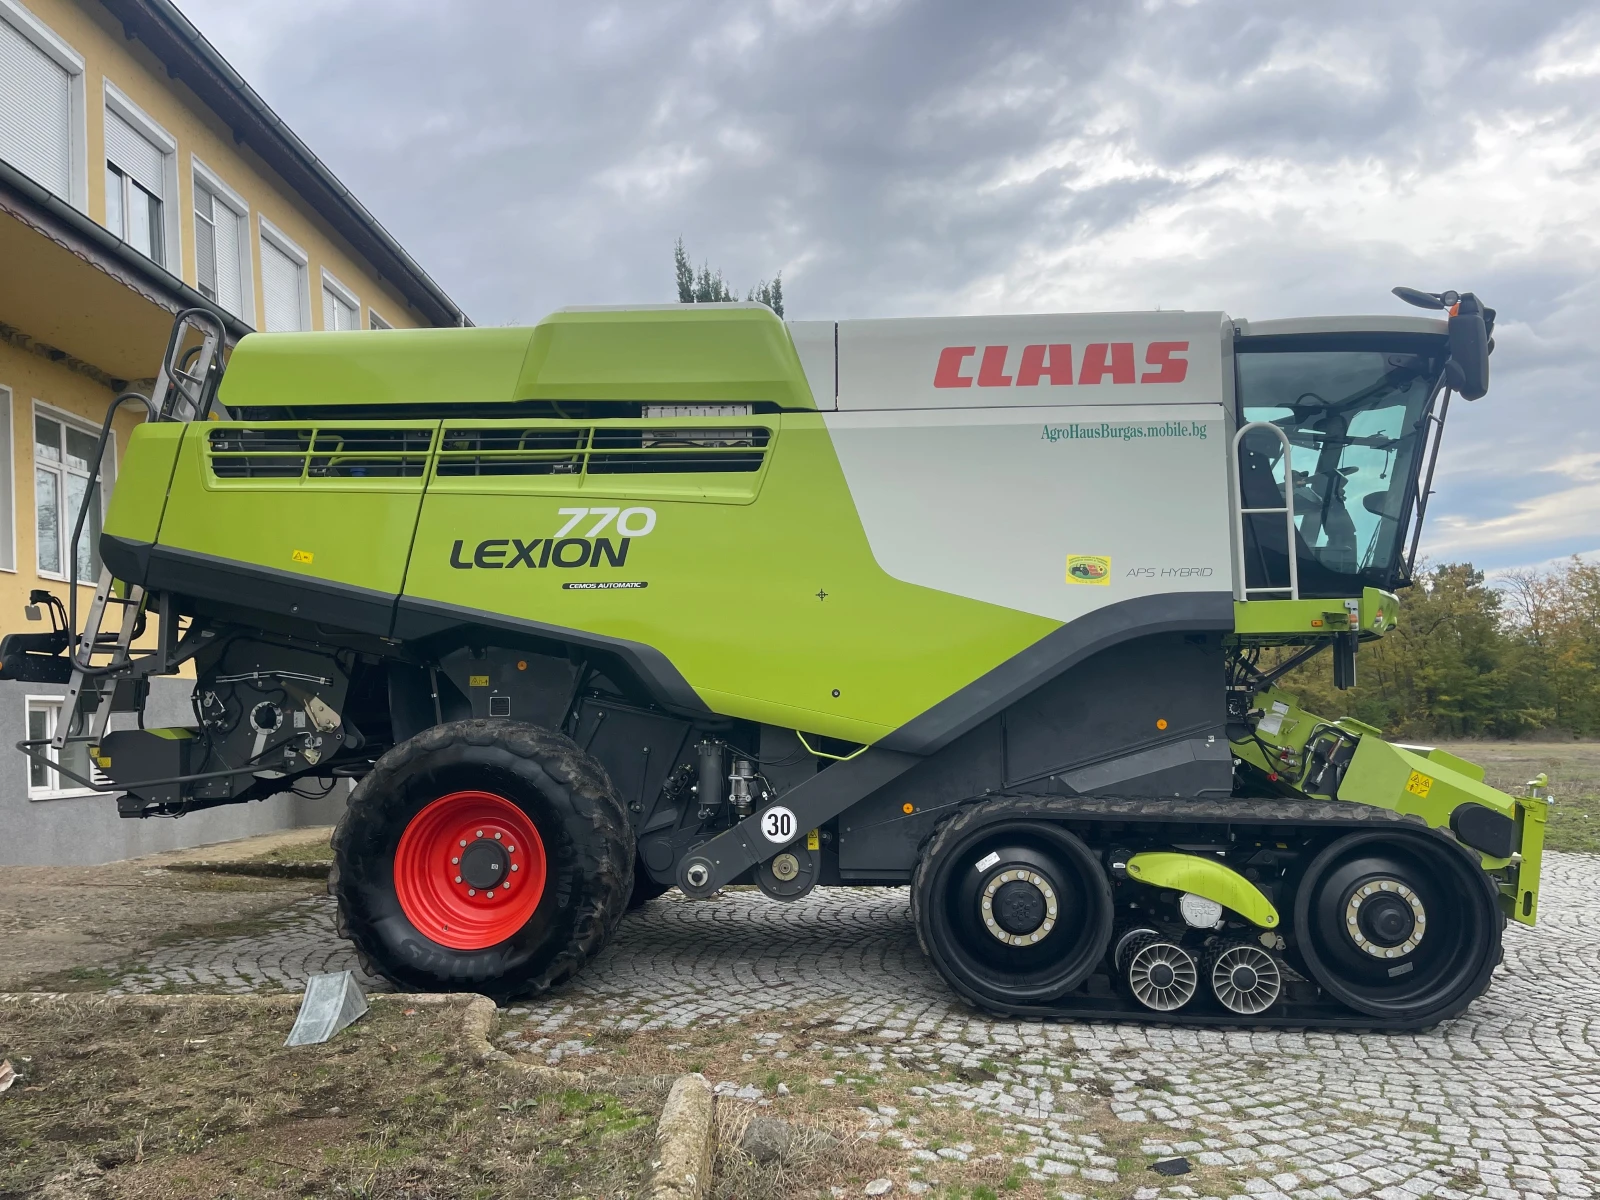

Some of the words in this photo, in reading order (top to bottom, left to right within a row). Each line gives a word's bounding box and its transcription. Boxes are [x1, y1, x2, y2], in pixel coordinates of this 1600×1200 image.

[933, 341, 1190, 389] CLAAS
[1041, 421, 1207, 443] AgroHausBurgas.mobile.bg
[553, 506, 657, 538] 770
[449, 537, 631, 569] LEXION
[1126, 567, 1157, 578] APS
[1160, 567, 1213, 578] HYBRID
[767, 813, 791, 836] 30
